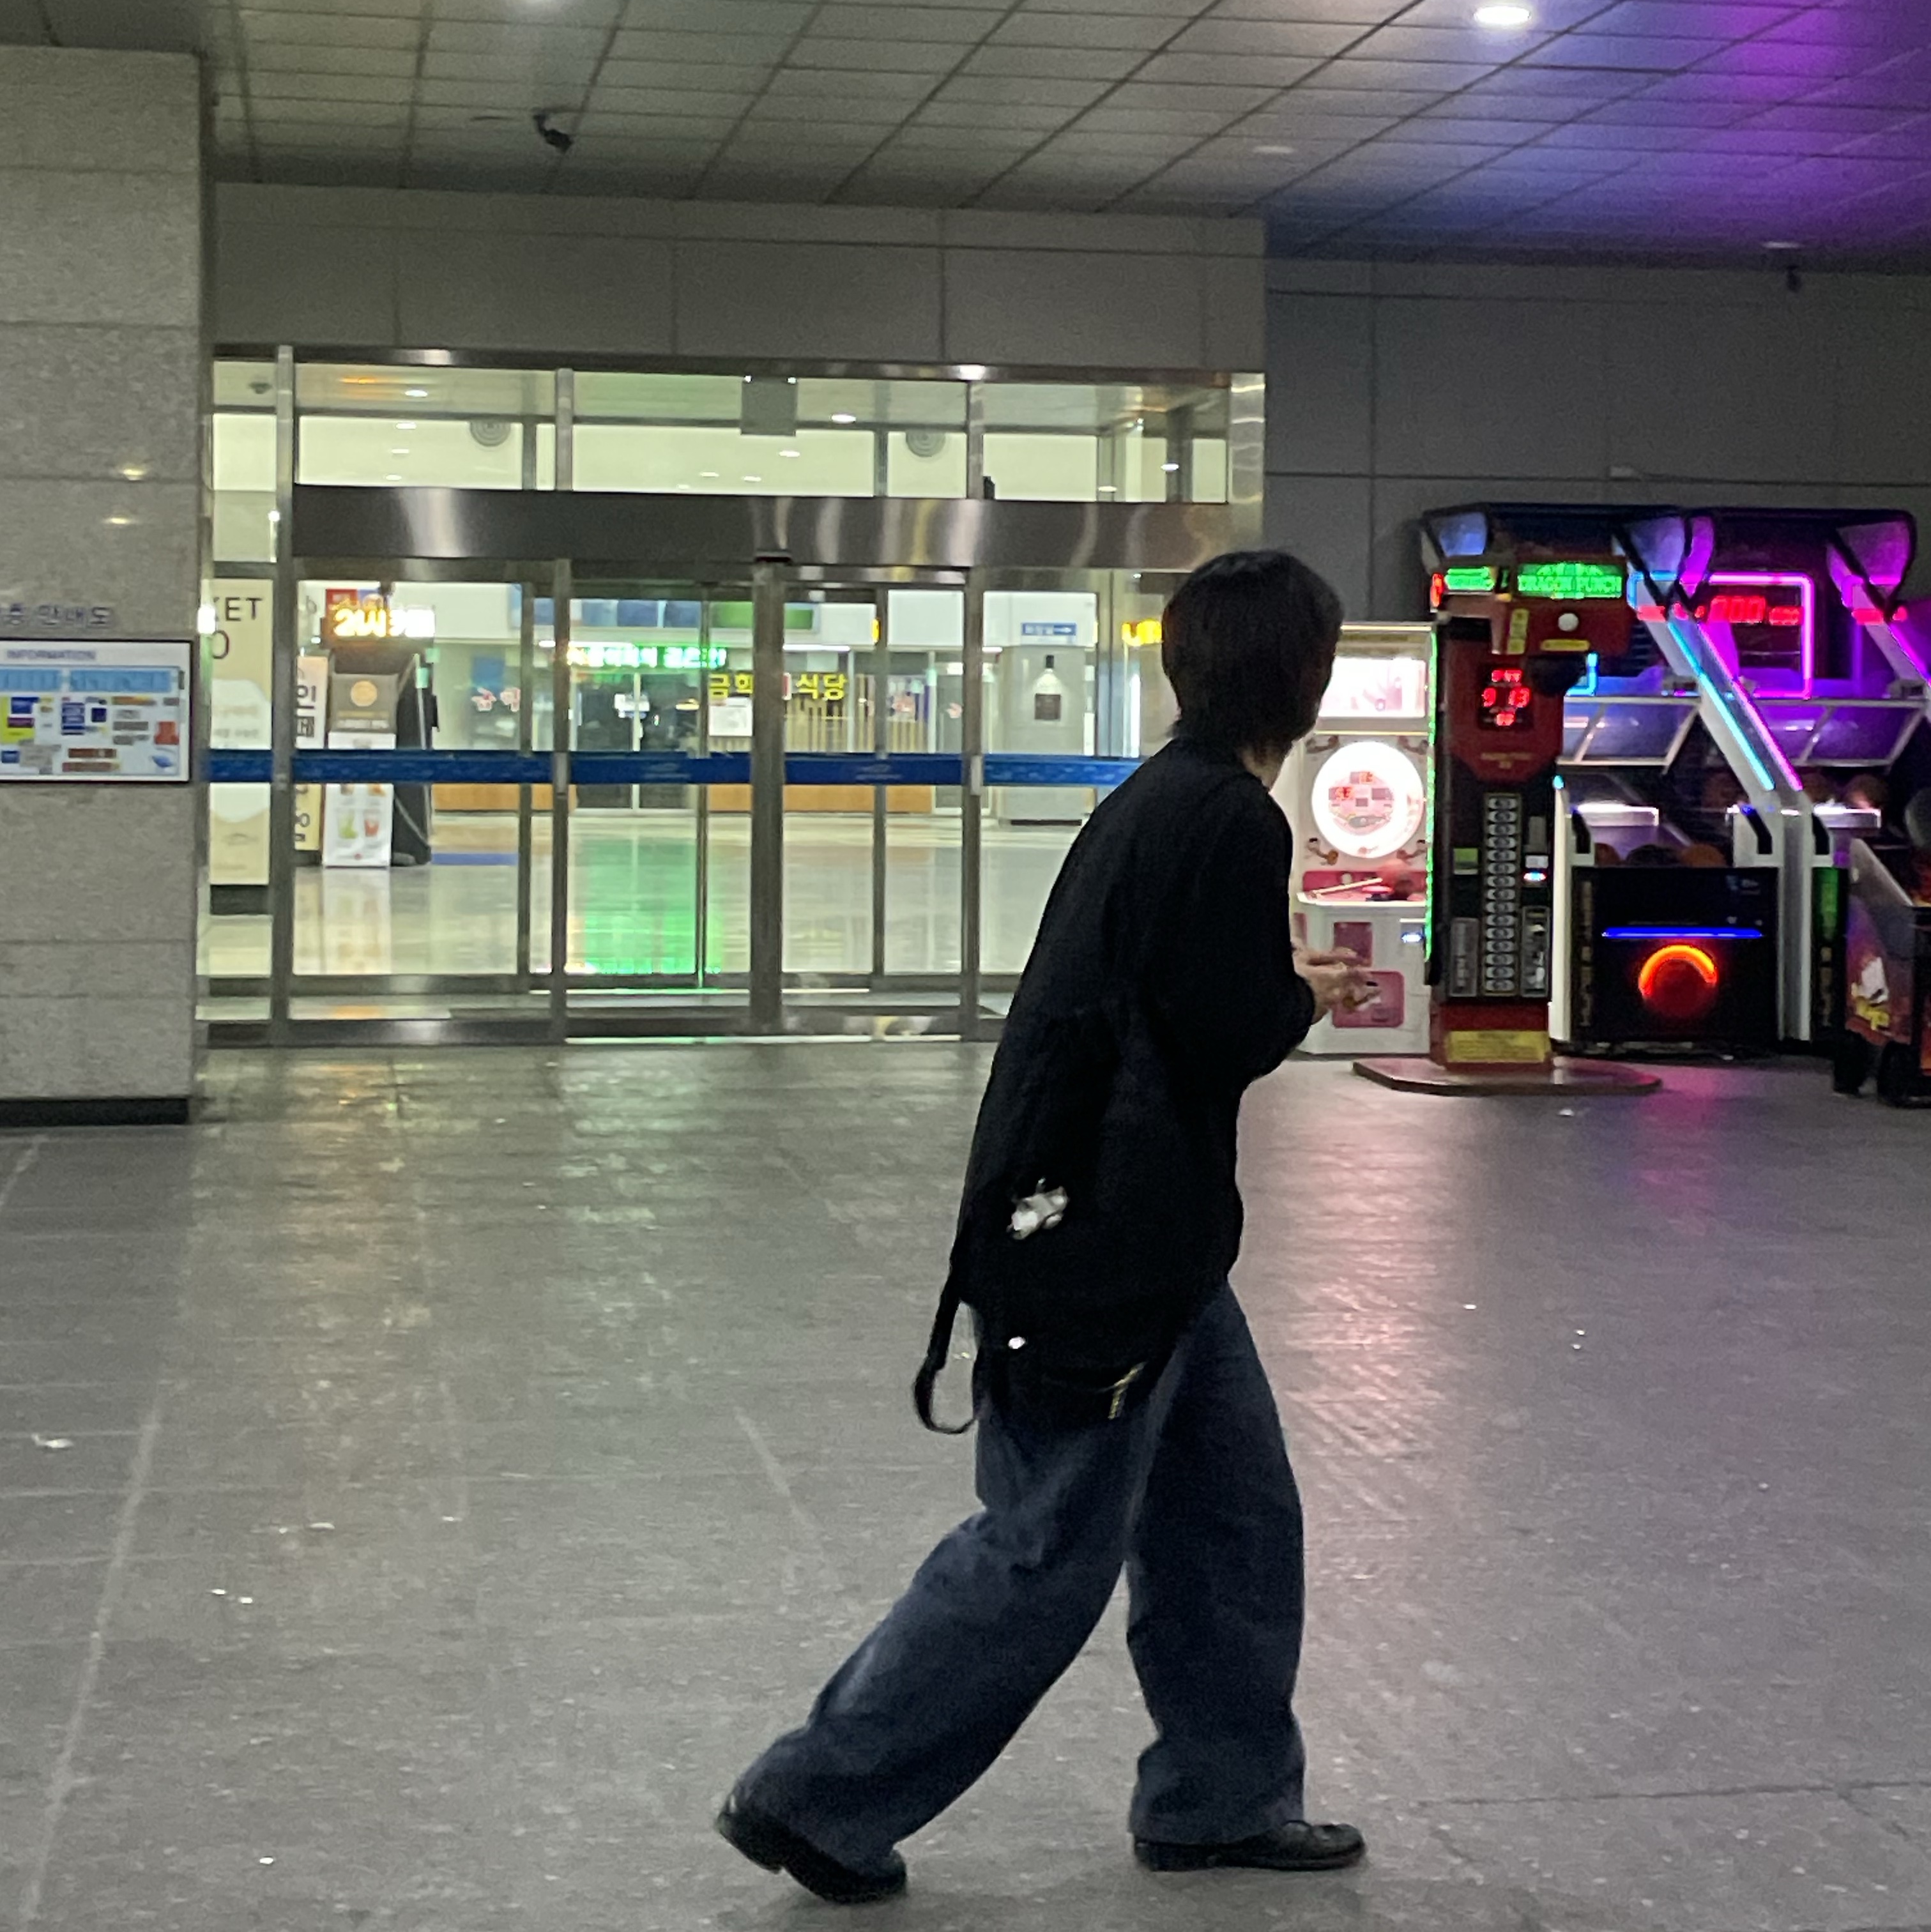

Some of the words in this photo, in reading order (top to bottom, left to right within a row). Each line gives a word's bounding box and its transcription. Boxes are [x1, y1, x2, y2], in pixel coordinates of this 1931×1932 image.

[1575, 575, 1622, 591] PUNCH
[213, 597, 263, 621] ET
[796, 673, 848, 700] 식당
